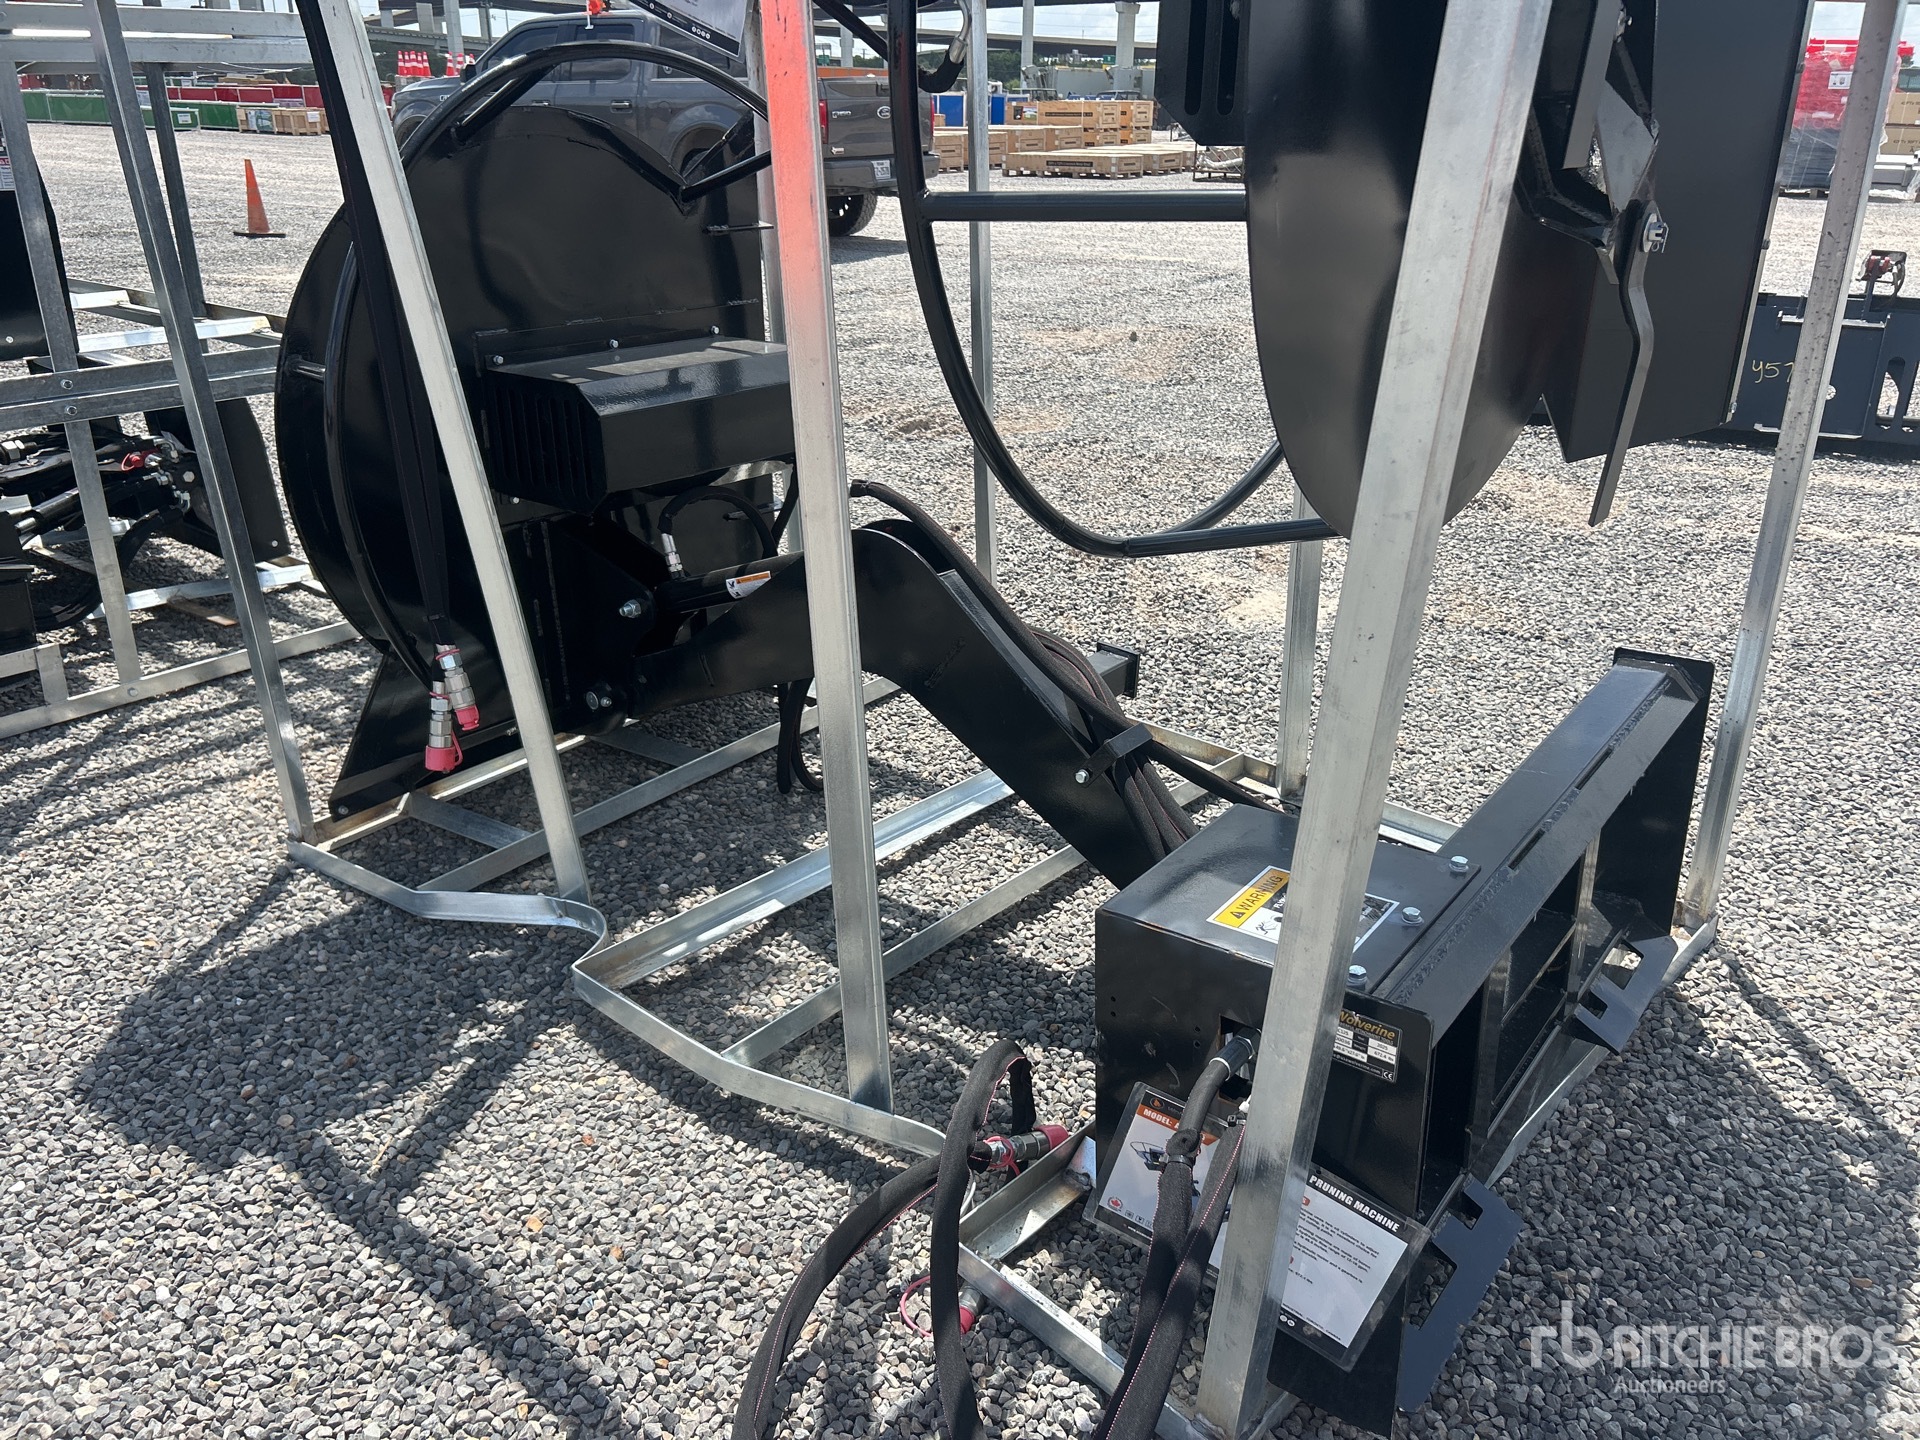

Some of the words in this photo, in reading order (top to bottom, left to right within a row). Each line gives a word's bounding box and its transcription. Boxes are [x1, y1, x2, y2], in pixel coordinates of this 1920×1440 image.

[1236, 876, 1283, 910] WARNING
[1309, 1175, 1354, 1206] PRUNING
[1353, 1200, 1400, 1233] MACHINE
